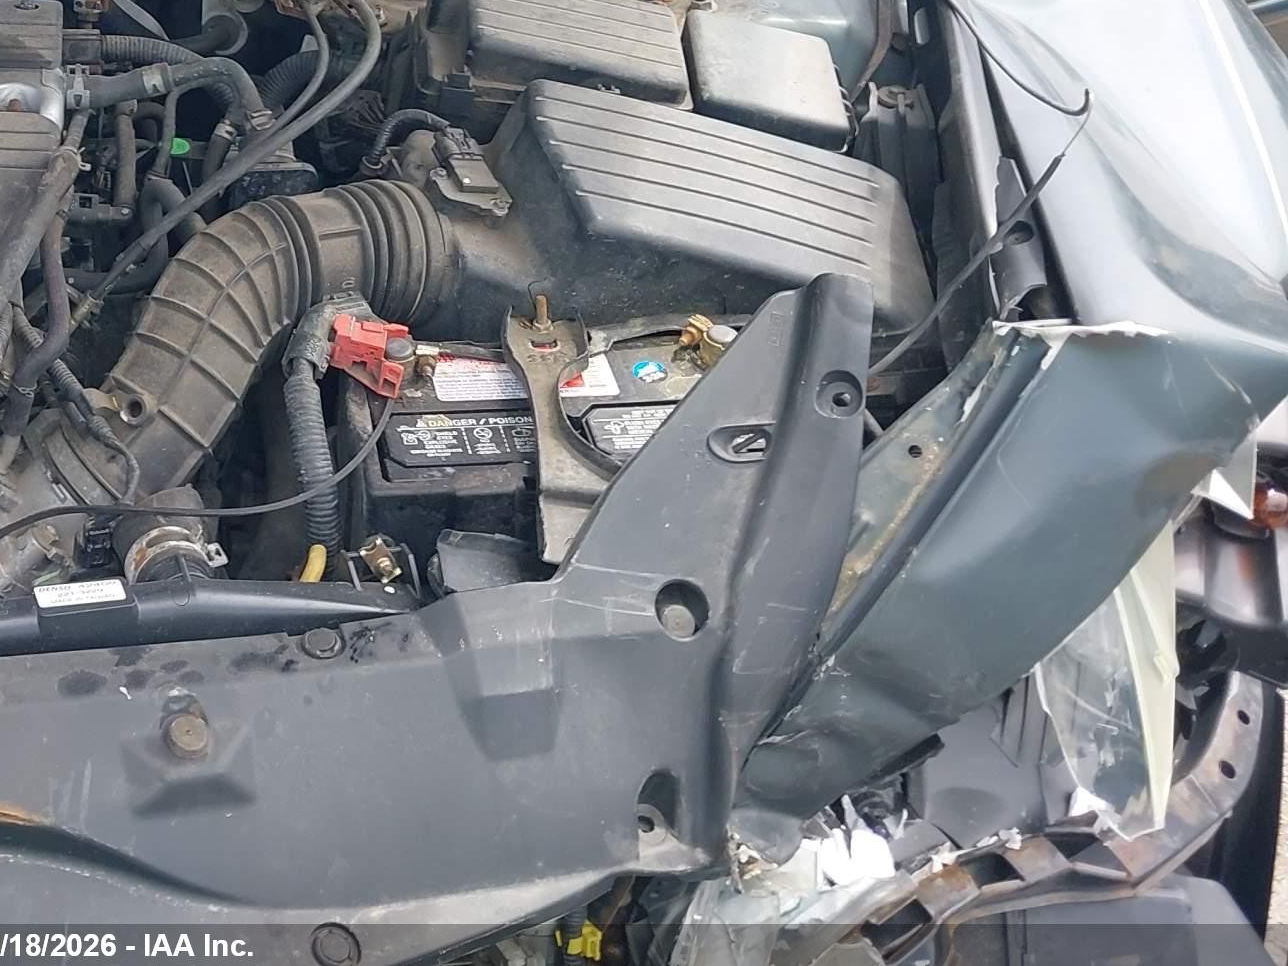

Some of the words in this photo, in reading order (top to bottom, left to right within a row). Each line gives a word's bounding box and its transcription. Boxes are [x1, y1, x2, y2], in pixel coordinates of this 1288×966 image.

[428, 418, 477, 427] DANGER
[488, 416, 533, 425] POISON
[38, 585, 71, 593] DENSO
